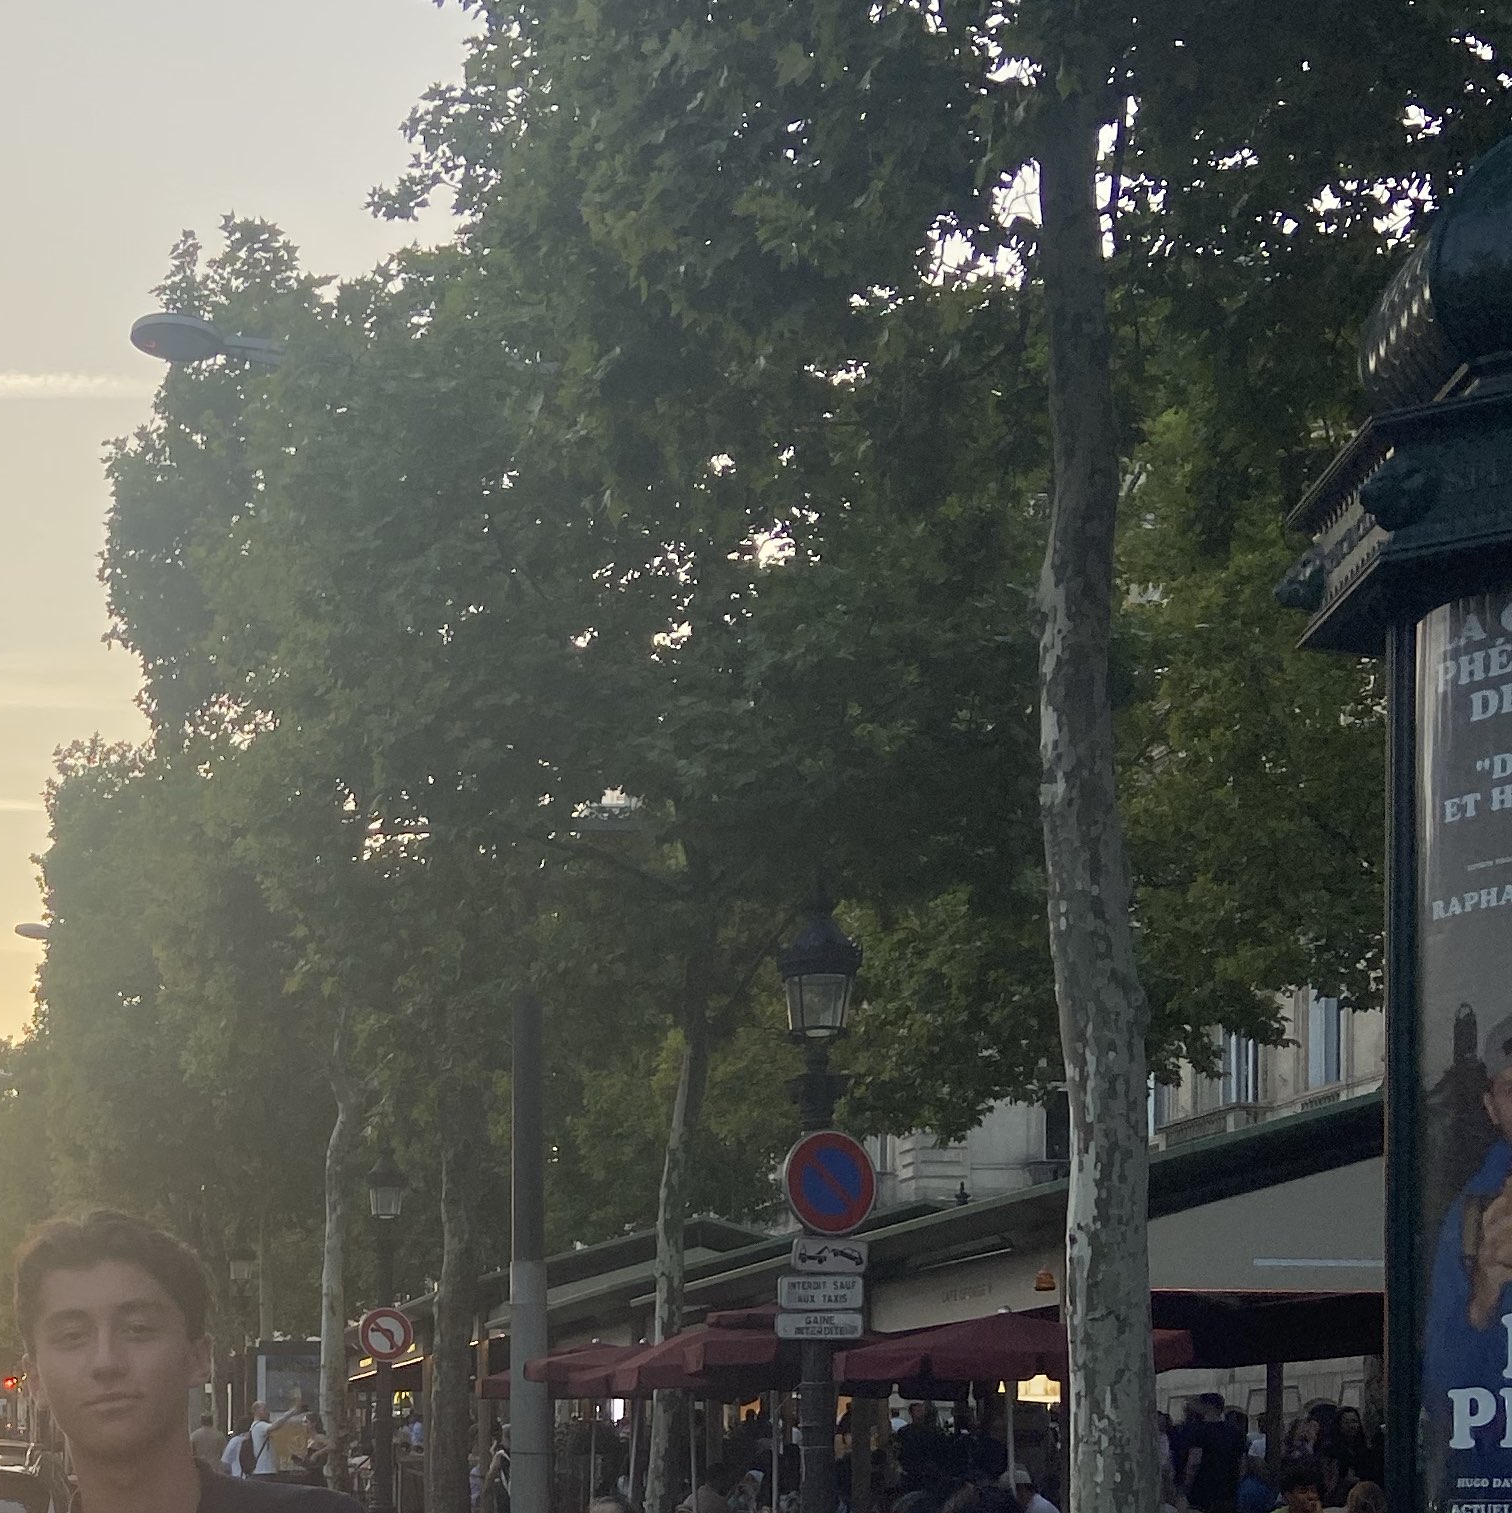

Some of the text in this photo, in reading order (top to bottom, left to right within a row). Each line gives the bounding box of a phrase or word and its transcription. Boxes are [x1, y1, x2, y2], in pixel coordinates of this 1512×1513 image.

[1444, 793, 1481, 823] ET
[788, 1281, 857, 1290] INTERDIT SAUF
[797, 1294, 848, 1303] AUX TAXIS
[1456, 1477, 1489, 1488] HUGO
